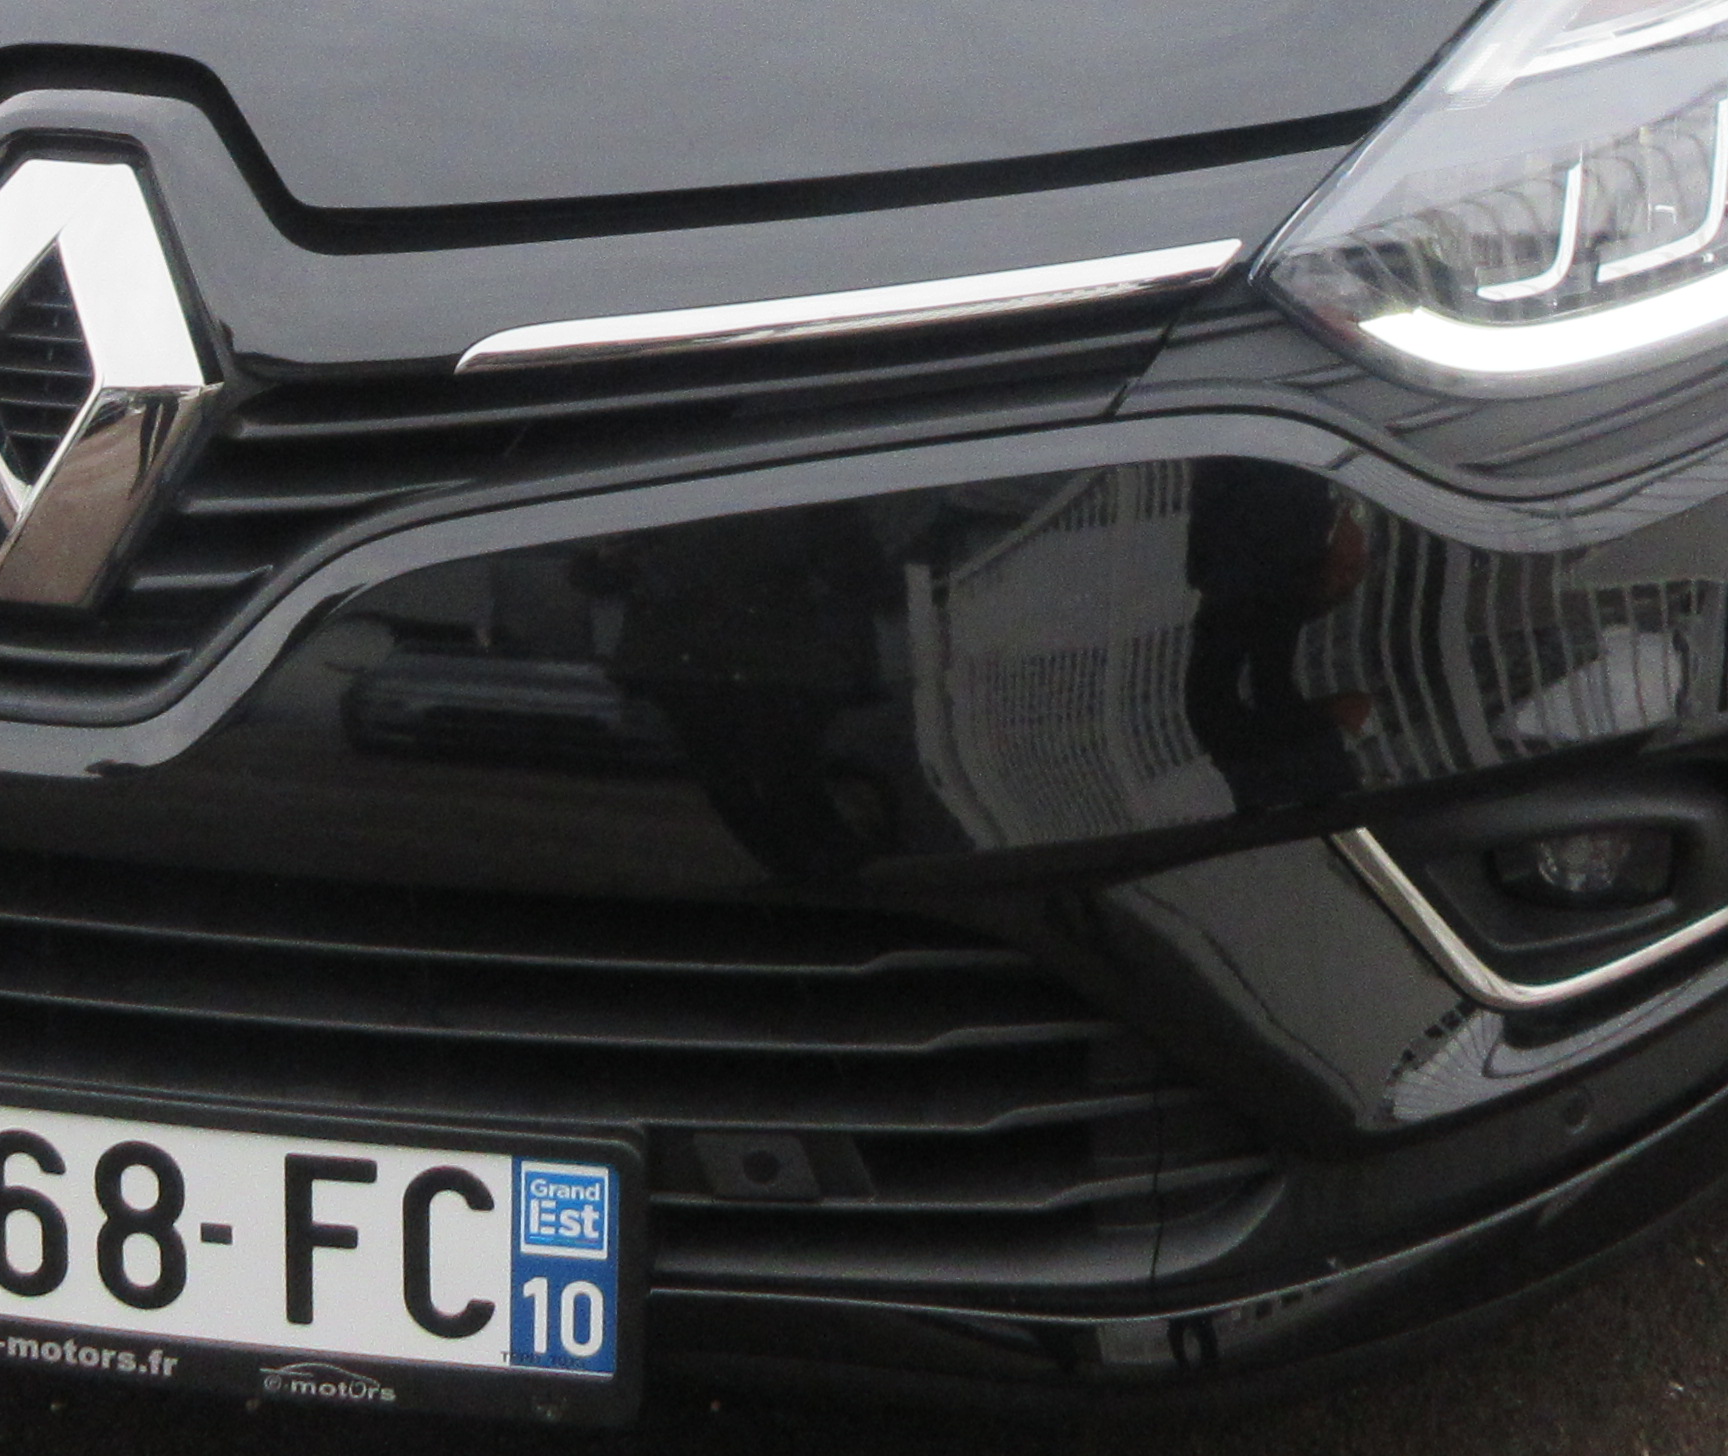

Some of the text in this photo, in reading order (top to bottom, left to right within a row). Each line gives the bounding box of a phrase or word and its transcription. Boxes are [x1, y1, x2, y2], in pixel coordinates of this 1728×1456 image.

[530, 1178, 602, 1201] Grand
[529, 1198, 600, 1239] Est
[523, 1276, 604, 1358] 10
